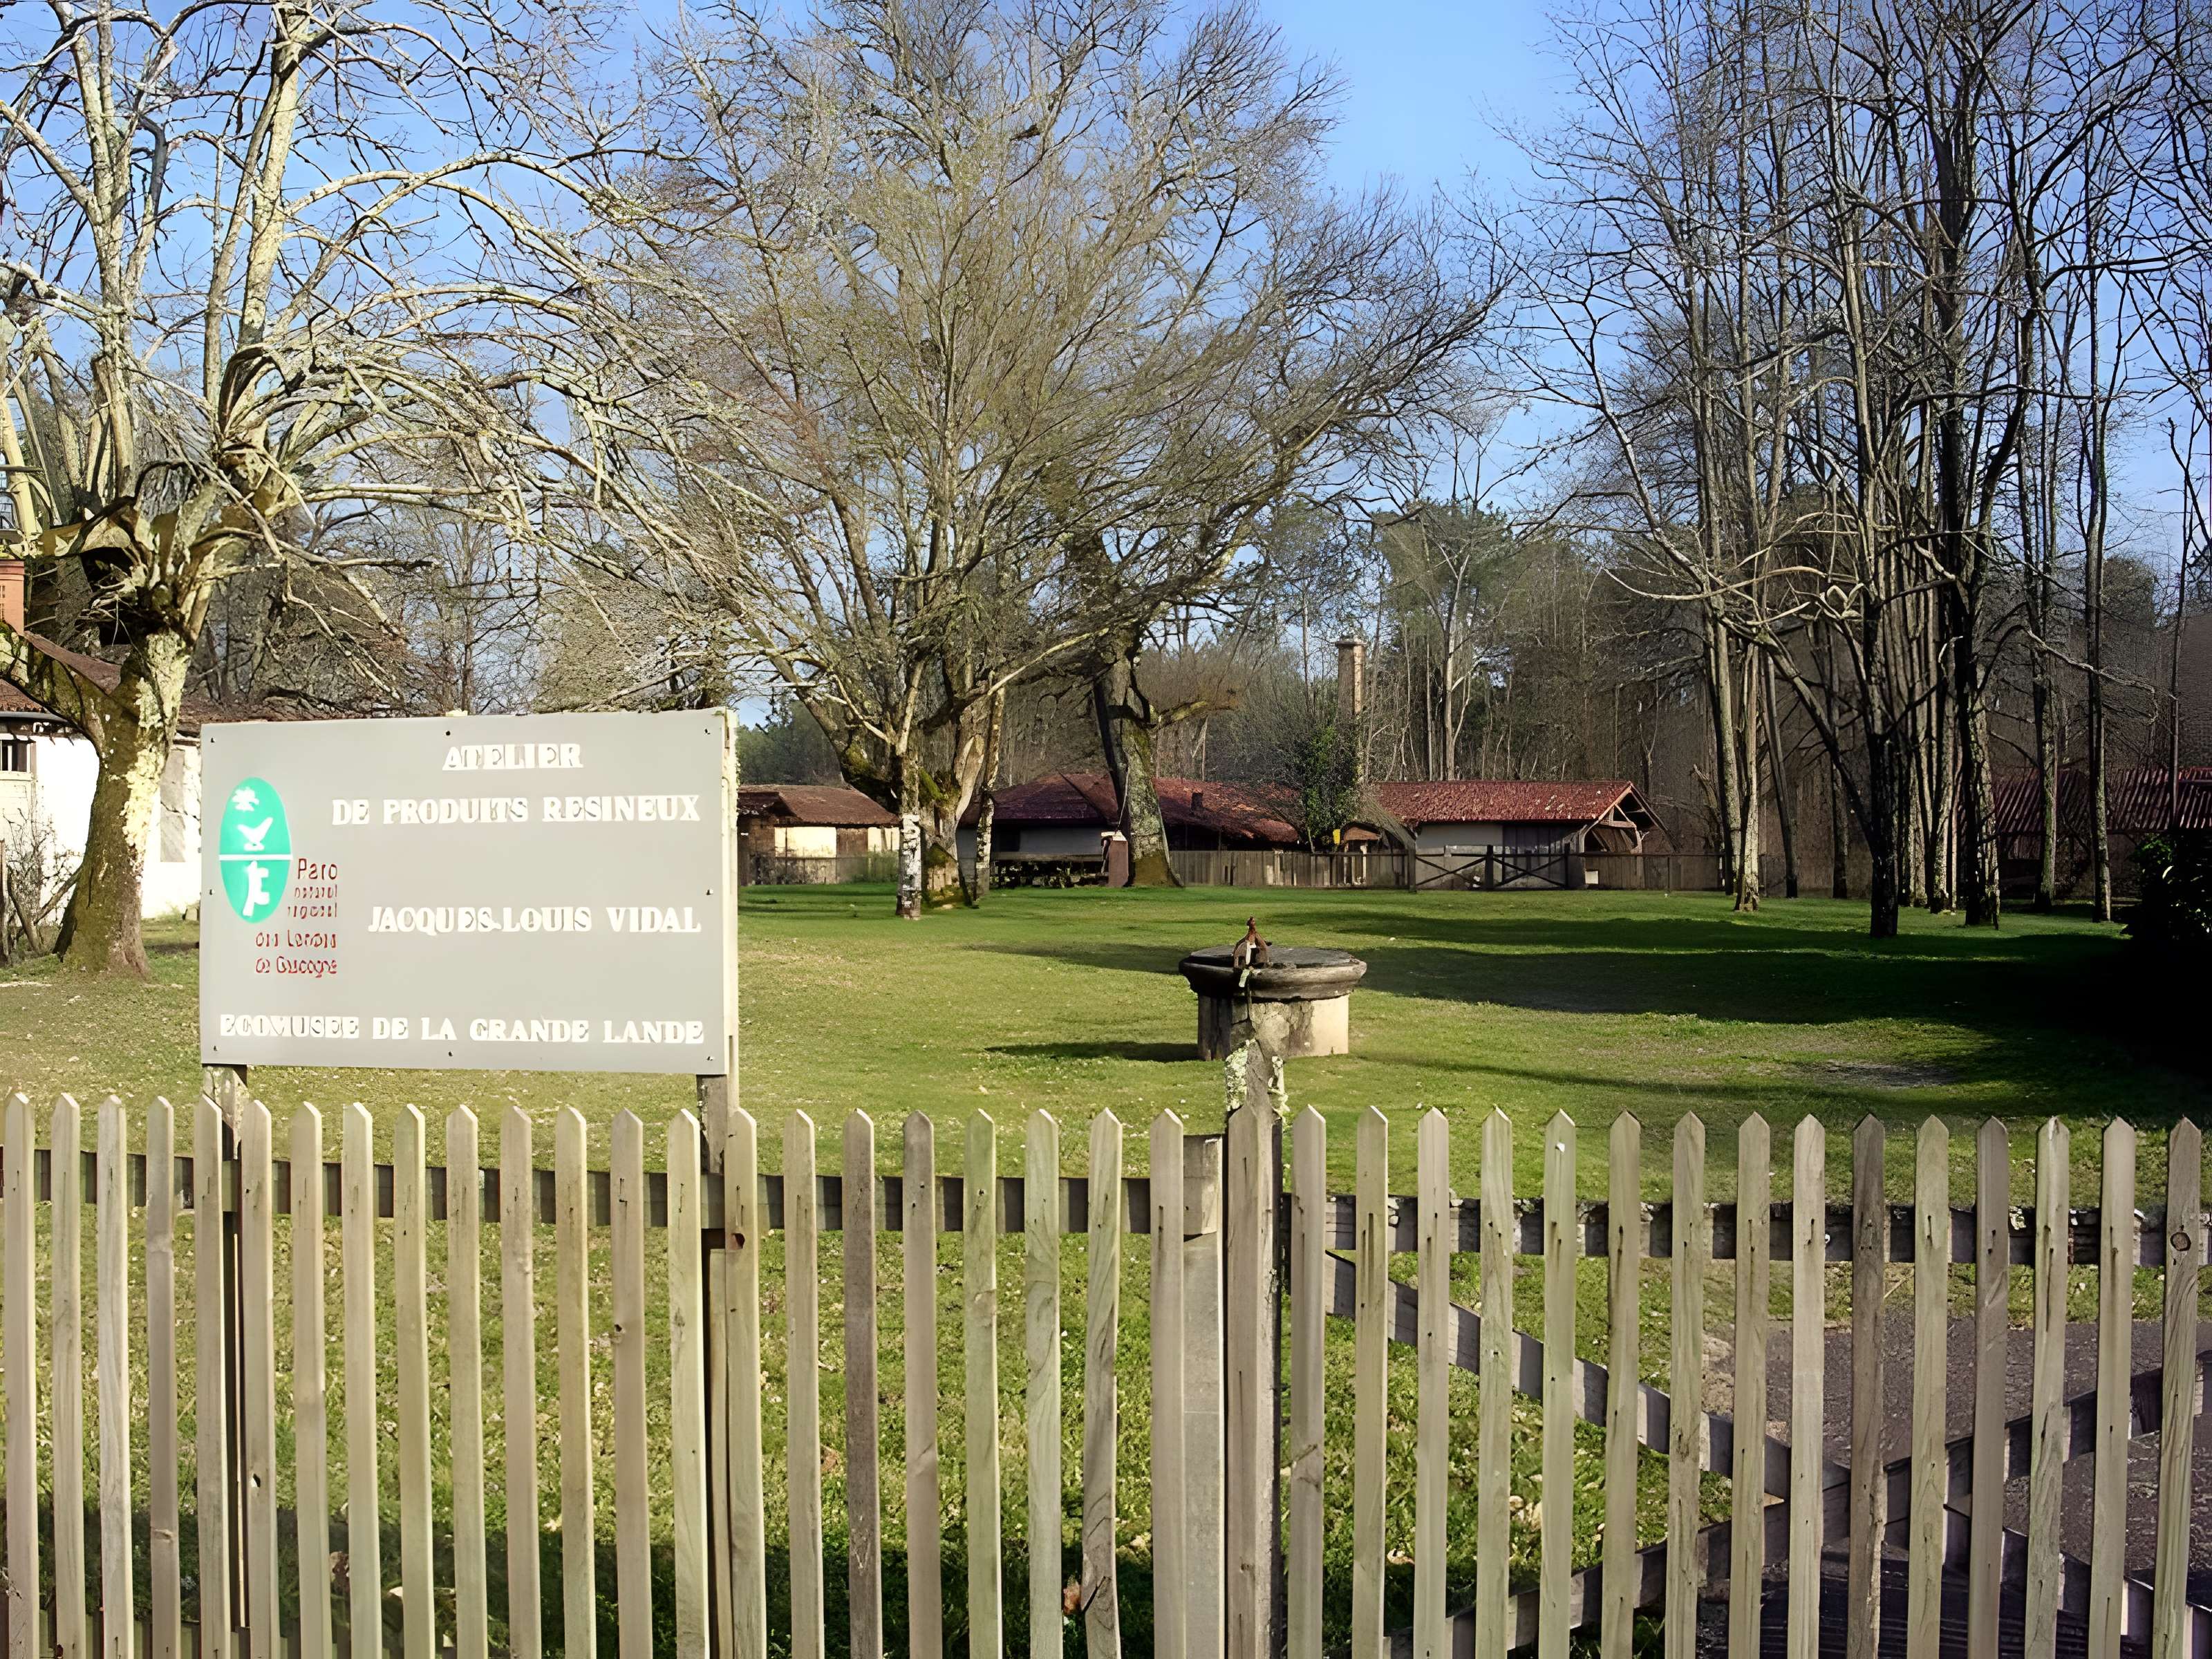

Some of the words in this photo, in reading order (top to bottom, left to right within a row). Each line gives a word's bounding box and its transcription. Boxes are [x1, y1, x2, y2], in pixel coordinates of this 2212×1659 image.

[442, 743, 583, 771] ATELIER
[332, 799, 370, 825] DE
[383, 797, 529, 825] PRODUITS
[542, 795, 700, 822] RESINEUX
[606, 906, 702, 932] VIDAL
[220, 1014, 359, 1039] ECOMUSEE
[373, 1017, 409, 1040] DE
[420, 1017, 458, 1040] LA
[469, 1018, 589, 1042] GRANDE
[603, 1020, 704, 1044] LANDE
